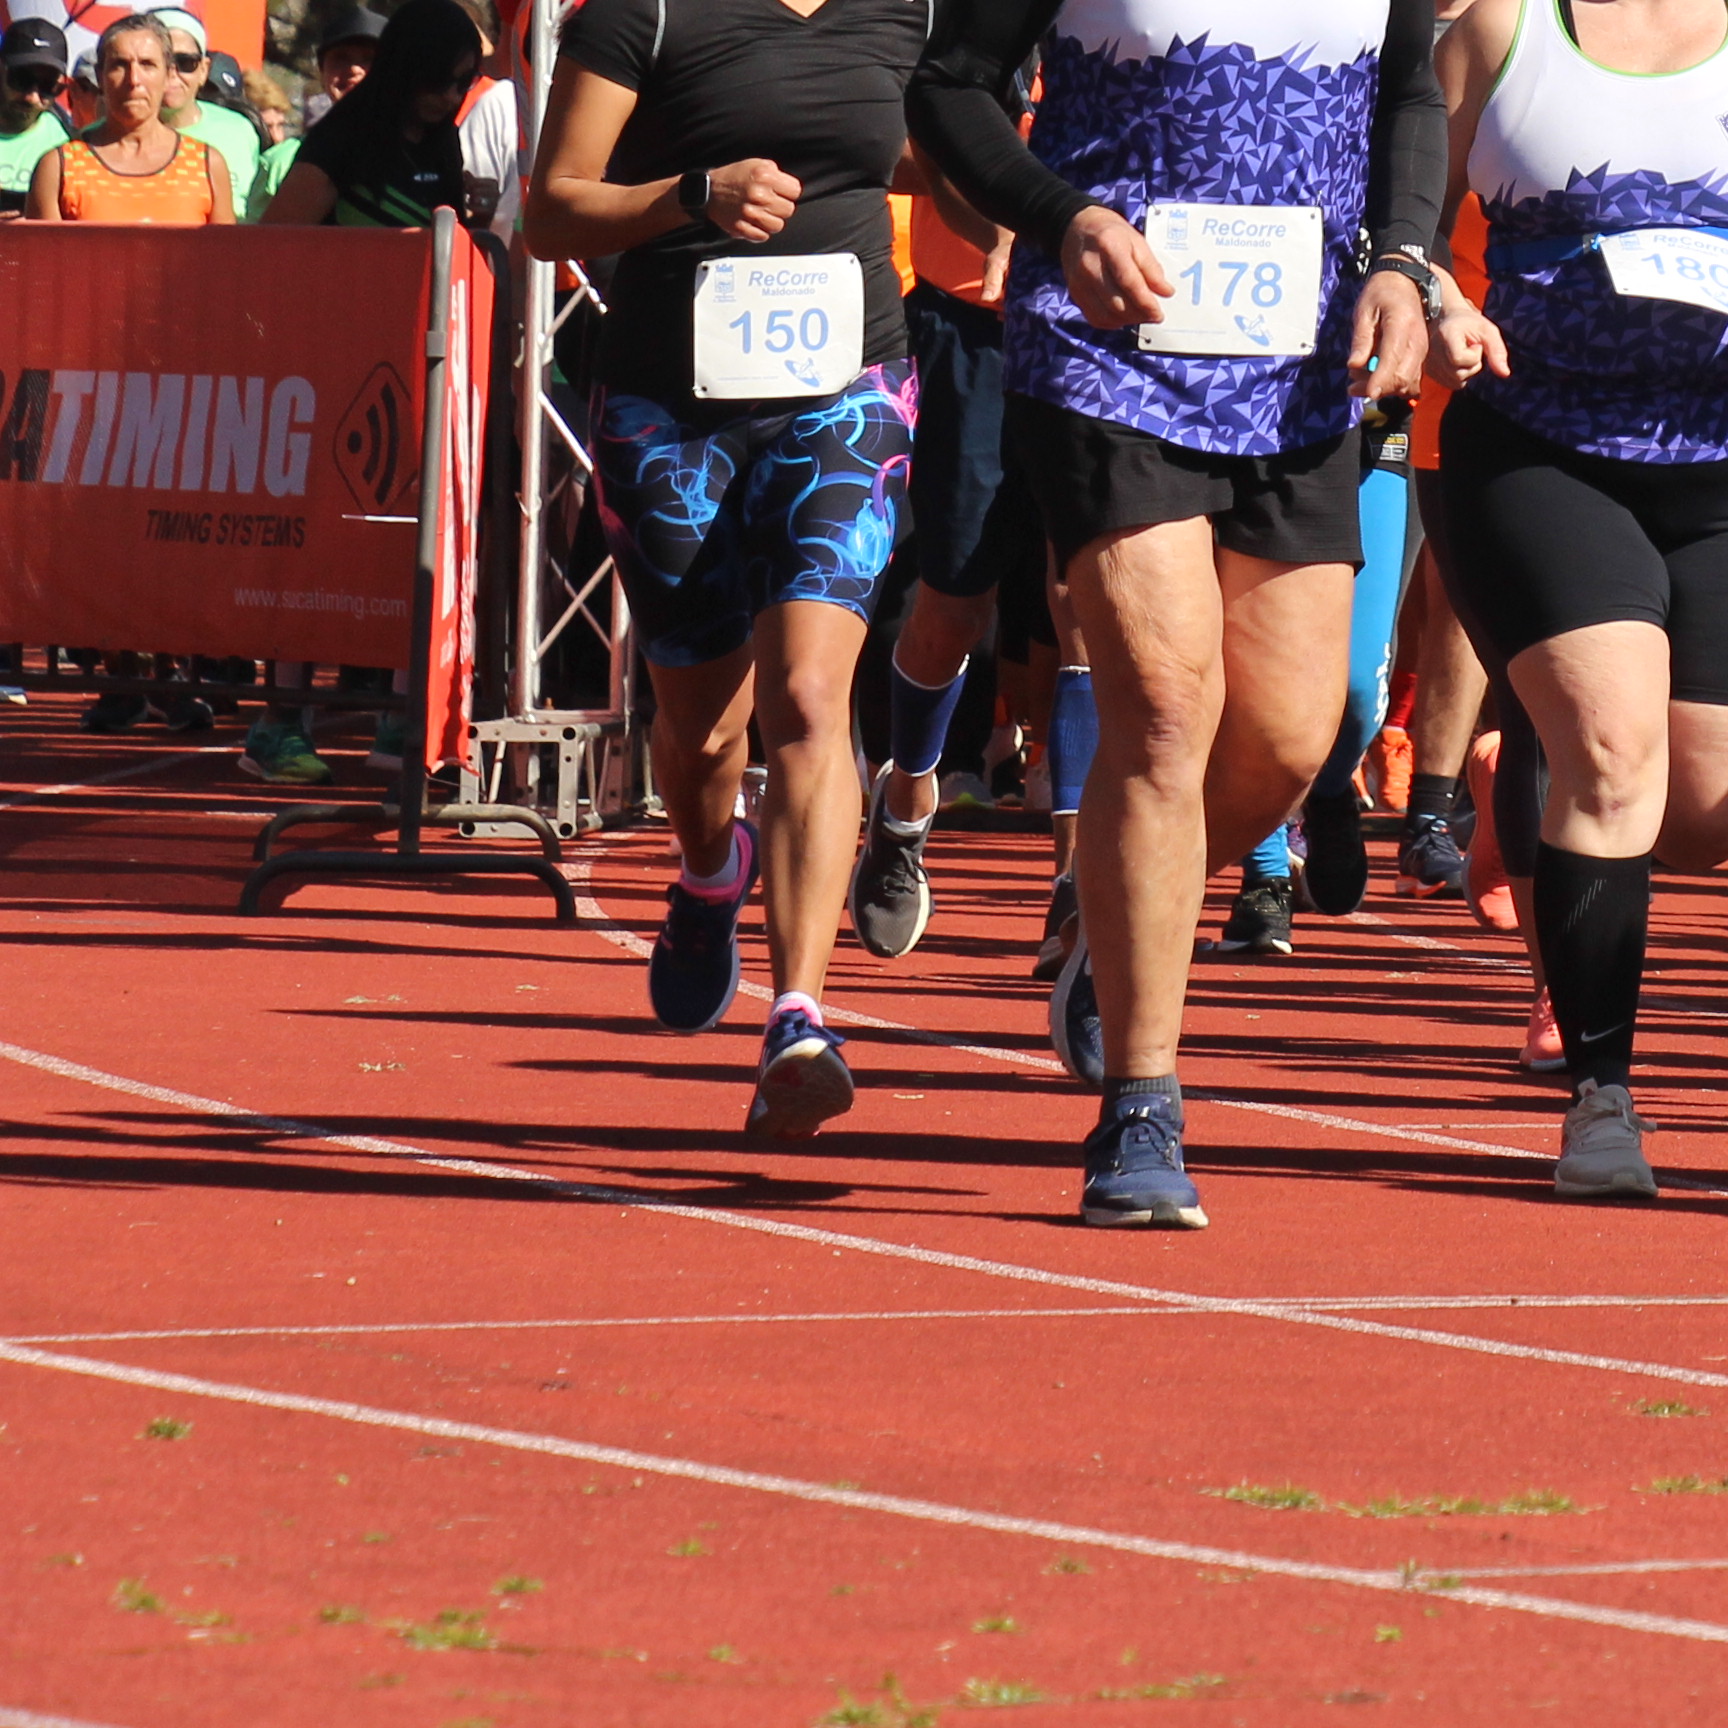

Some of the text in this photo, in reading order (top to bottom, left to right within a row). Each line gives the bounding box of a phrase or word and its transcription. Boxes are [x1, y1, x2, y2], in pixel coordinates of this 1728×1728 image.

[1202, 218, 1287, 238] ReCorre
[1215, 238, 1271, 248] Maldonado
[749, 270, 828, 287] ReCorre
[762, 287, 815, 296] Maldonado
[1179, 259, 1282, 308] 178
[729, 308, 829, 354] 150
[0, 369, 316, 498] ATIMING
[147, 509, 306, 549] TIMING SYSTEMS
